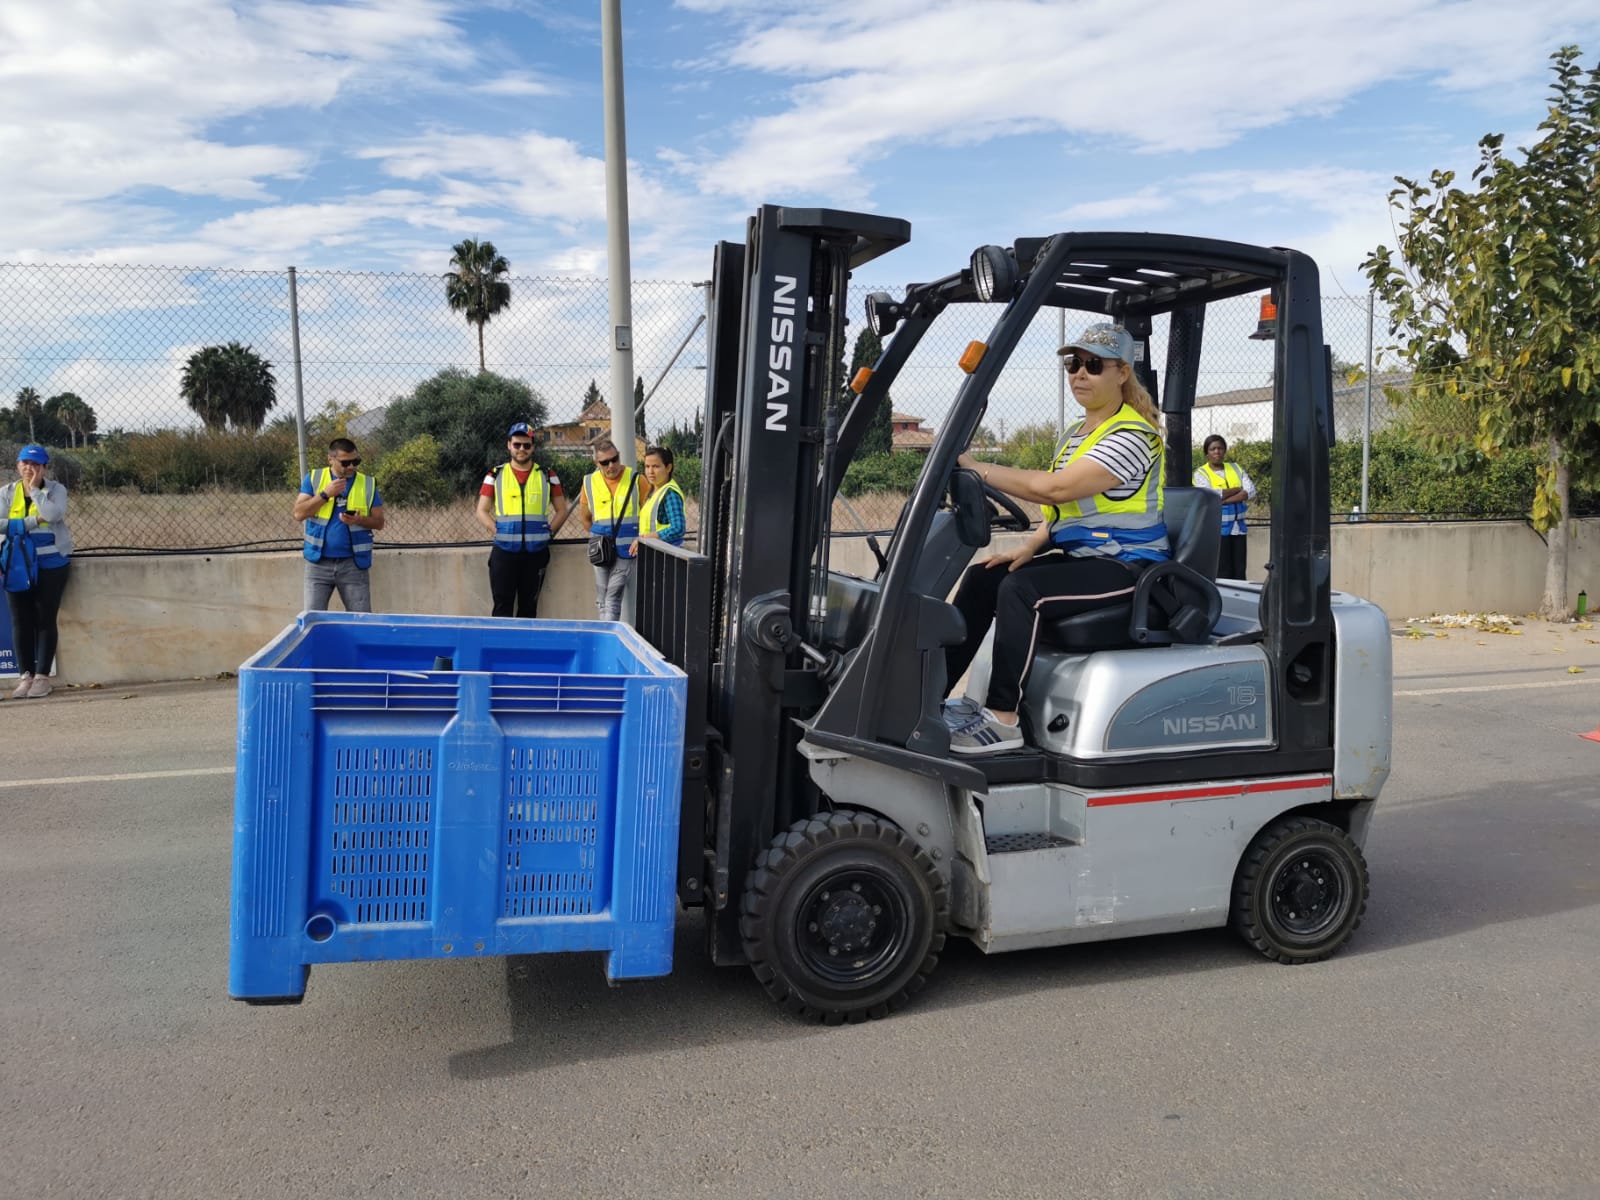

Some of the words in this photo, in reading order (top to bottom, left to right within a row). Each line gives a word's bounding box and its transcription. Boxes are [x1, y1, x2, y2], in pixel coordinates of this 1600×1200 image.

[765, 275, 797, 431] NISSAN
[1227, 686, 1257, 705] 18
[1163, 714, 1256, 735] NISSAN
